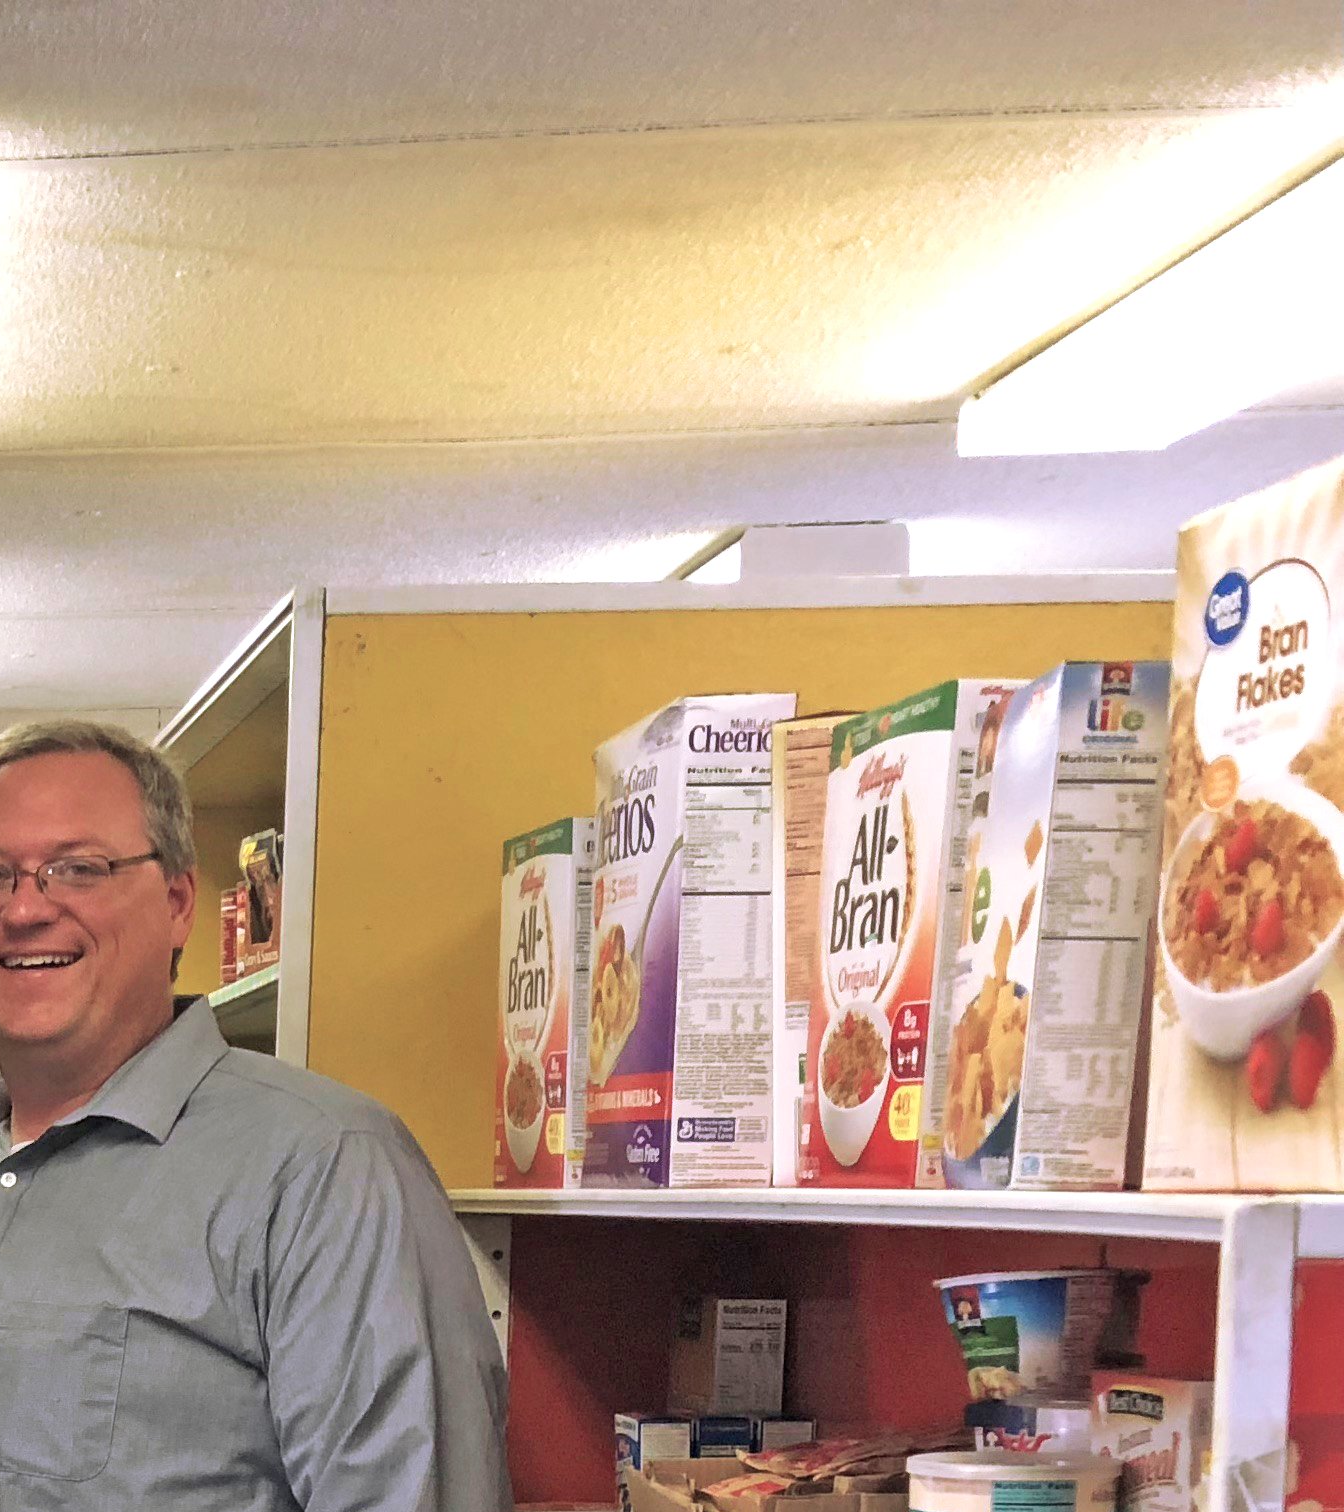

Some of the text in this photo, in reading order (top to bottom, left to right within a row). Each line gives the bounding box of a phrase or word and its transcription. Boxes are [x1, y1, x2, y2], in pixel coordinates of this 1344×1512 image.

[1258, 619, 1309, 664] Bran
[1235, 663, 1306, 714] Flakes
[628, 761, 659, 795] Grain
[1059, 753, 1158, 764] Nutrition Facts
[829, 875, 900, 955] Bran
[507, 956, 547, 1014] Bran
[837, 960, 881, 996] Original
